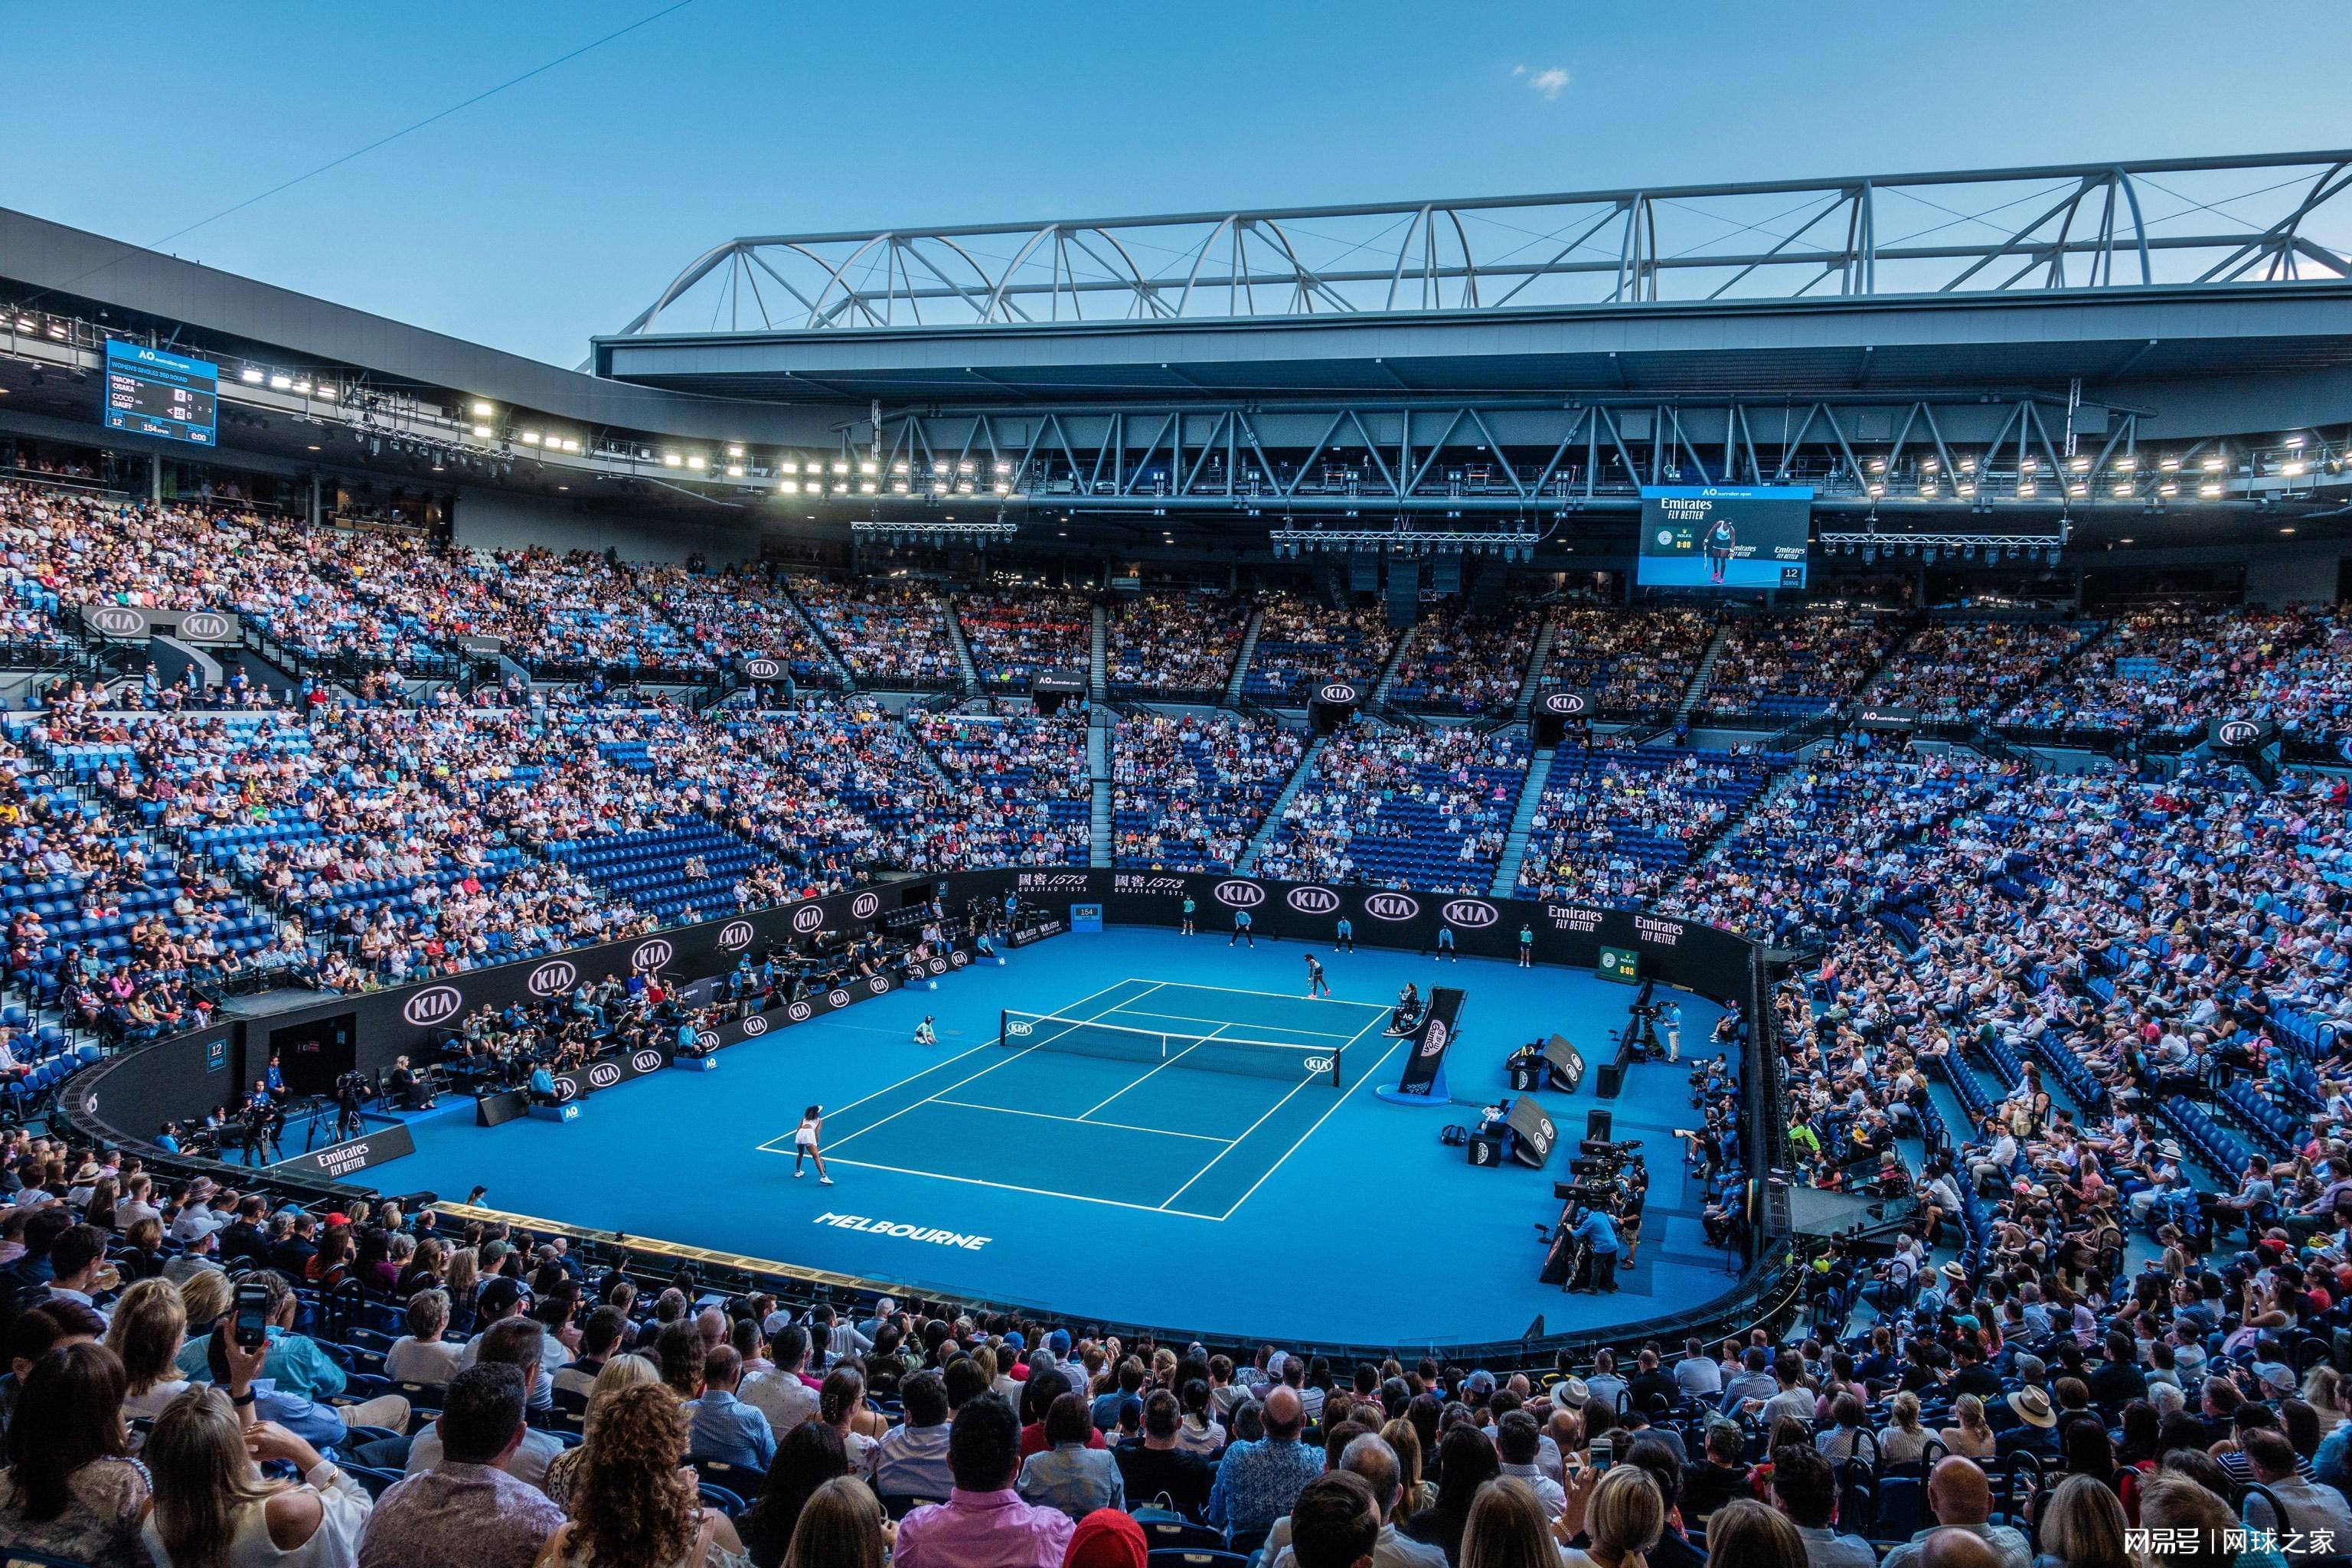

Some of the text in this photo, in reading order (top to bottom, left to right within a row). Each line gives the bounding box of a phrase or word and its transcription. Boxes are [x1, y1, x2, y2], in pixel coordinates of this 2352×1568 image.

[139, 350, 155, 361] AO
[138, 368, 158, 377] SINGLES
[113, 375, 135, 386] NAOMI
[113, 383, 135, 393] OSAKA
[113, 394, 135, 403] COCO
[113, 400, 133, 410] GAUFF
[1661, 498, 1712, 510] Emirates
[1668, 510, 1704, 520] FLY BETTER
[1677, 541, 1691, 549] 0:00
[1785, 569, 1798, 577] 12
[101, 616, 136, 630] KIA
[190, 618, 221, 633] KIA
[751, 663, 773, 675] KIA
[1327, 688, 1349, 698] KIA
[1553, 697, 1577, 709] KIA
[1861, 712, 1877, 720] AO
[1223, 885, 1256, 902] KIA
[857, 897, 874, 914] KIA
[1296, 891, 1330, 909] KIA
[1374, 898, 1410, 915] KIA
[799, 910, 818, 928] KIA
[1452, 904, 1488, 922] KIA
[1548, 905, 1602, 922] Emirates
[1556, 920, 1595, 932] FLY BETTER
[1635, 915, 1684, 935] Emirates
[726, 926, 748, 944] KIA
[1642, 930, 1676, 946] FLY BETTER
[639, 946, 665, 966] KIA
[954, 952, 965, 963] KIA
[932, 961, 945, 971] KIA
[1620, 965, 1634, 975] 0:00
[537, 967, 568, 991] KIA
[873, 980, 887, 991] KIA
[831, 992, 847, 1004] KIA
[414, 992, 452, 1019] KIA
[792, 1004, 808, 1018] KIA
[746, 1019, 764, 1033] KIA
[1011, 1024, 1027, 1033] KIA
[211, 1044, 222, 1056] 12
[636, 1054, 658, 1070] KIA
[706, 1058, 717, 1068] AO
[1308, 1060, 1328, 1070] KIA
[593, 1067, 616, 1083] KIA
[566, 1106, 578, 1118] AO
[316, 1143, 369, 1167] Emirates
[330, 1157, 366, 1176] FLY BETTER
[813, 1212, 993, 1251] MELBOURNE
